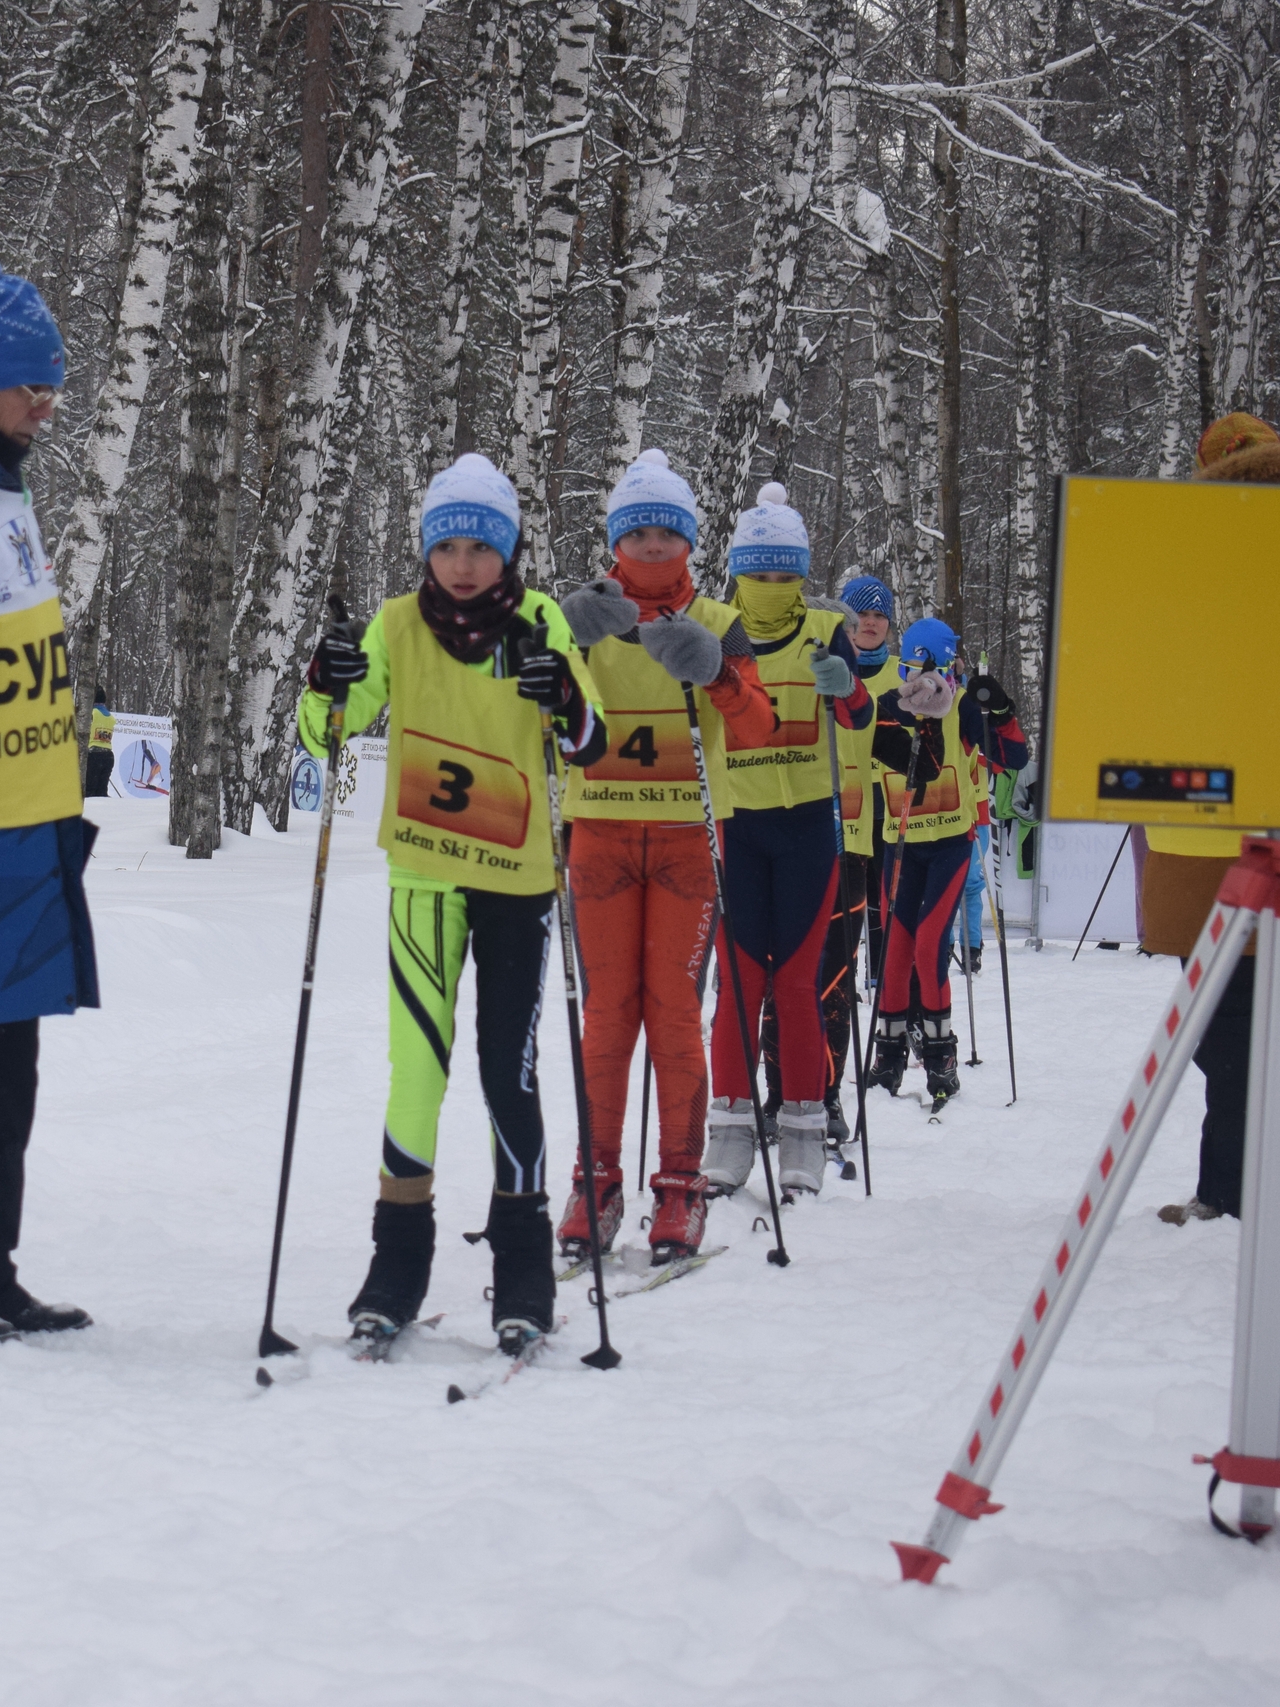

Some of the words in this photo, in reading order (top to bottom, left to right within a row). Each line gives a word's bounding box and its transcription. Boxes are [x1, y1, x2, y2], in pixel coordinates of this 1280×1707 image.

[613, 512, 677, 532] РОССИИ
[736, 554, 796, 565] РОССИИ
[618, 725, 658, 767] 4
[429, 759, 474, 813] 3
[639, 787, 665, 801] Ski
[937, 815, 962, 825] Tour
[439, 838, 469, 860] Ski
[474, 847, 523, 871] Tour
